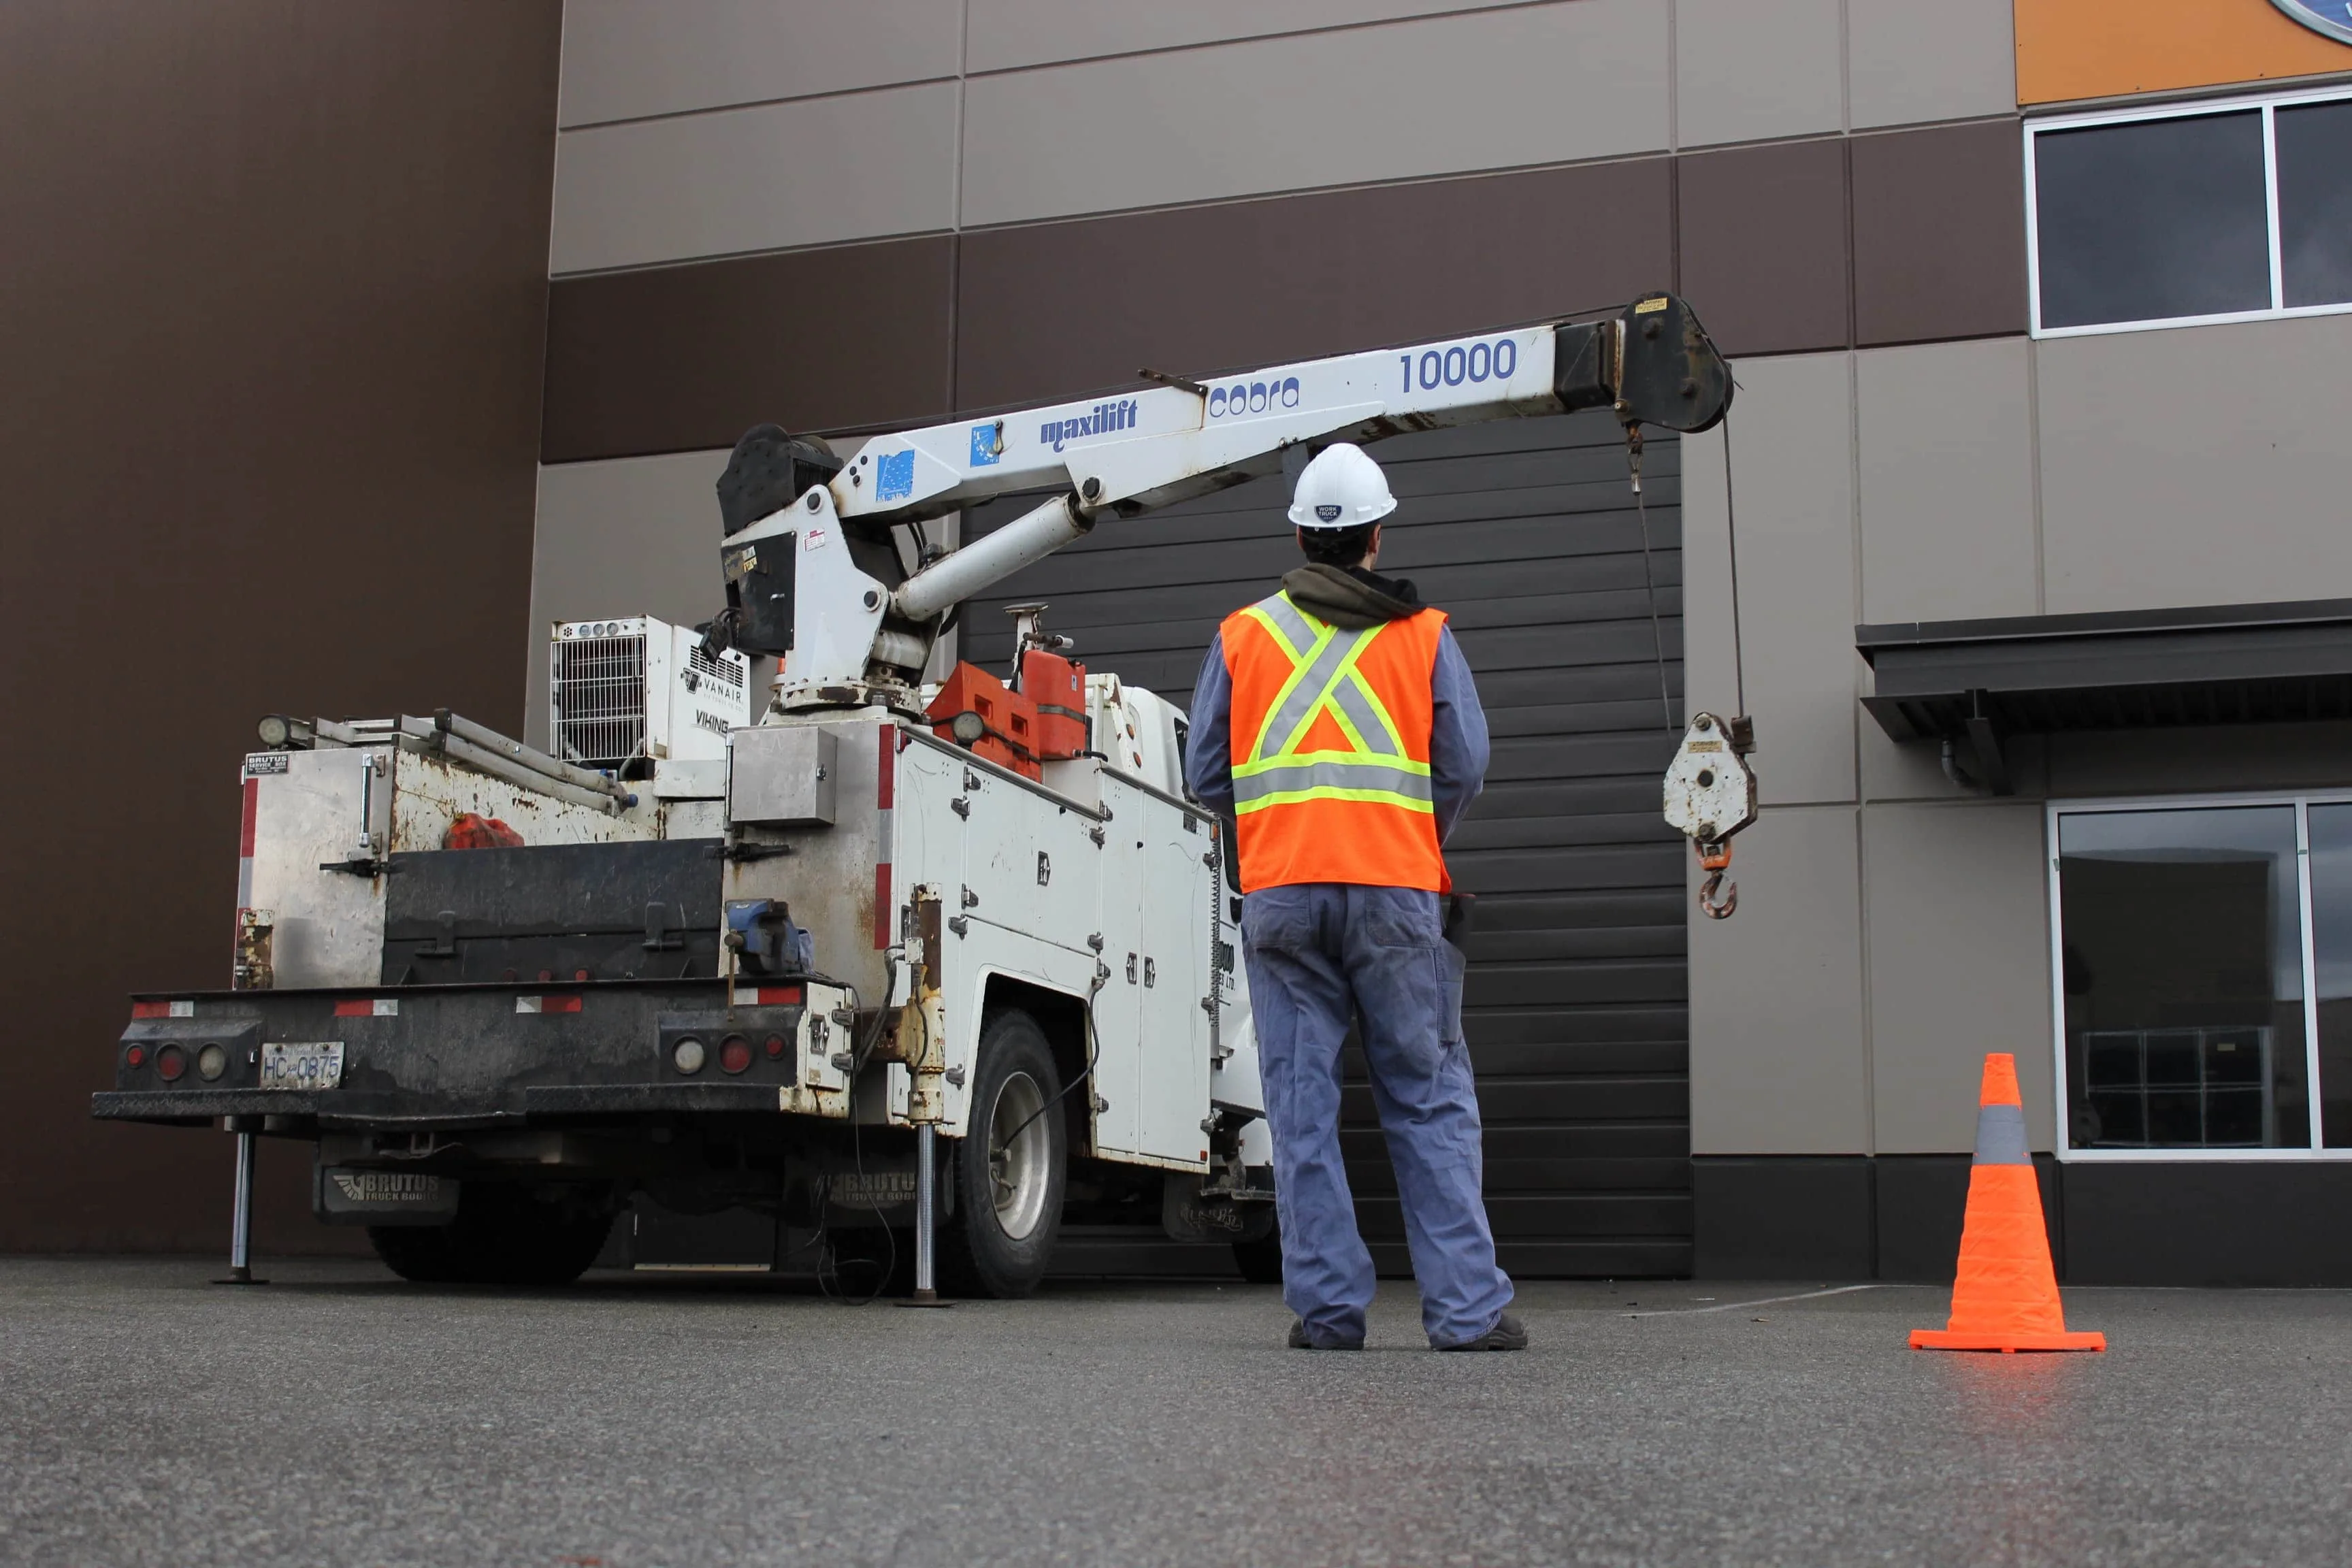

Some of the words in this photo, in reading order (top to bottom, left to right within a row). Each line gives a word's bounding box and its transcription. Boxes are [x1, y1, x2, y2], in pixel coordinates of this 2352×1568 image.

[1041, 399, 1138, 453] maxilift
[1209, 376, 1299, 418] cobra
[1401, 339, 1516, 393] 10000
[704, 678, 741, 703] VANAIR
[696, 709, 729, 734] VIKING
[248, 755, 287, 764] BRUTUS
[297, 1055, 340, 1079] 0875
[365, 1174, 439, 1192] BRUTUS
[845, 1173, 915, 1191] BRUTU
[365, 1192, 399, 1200] TRUCK
